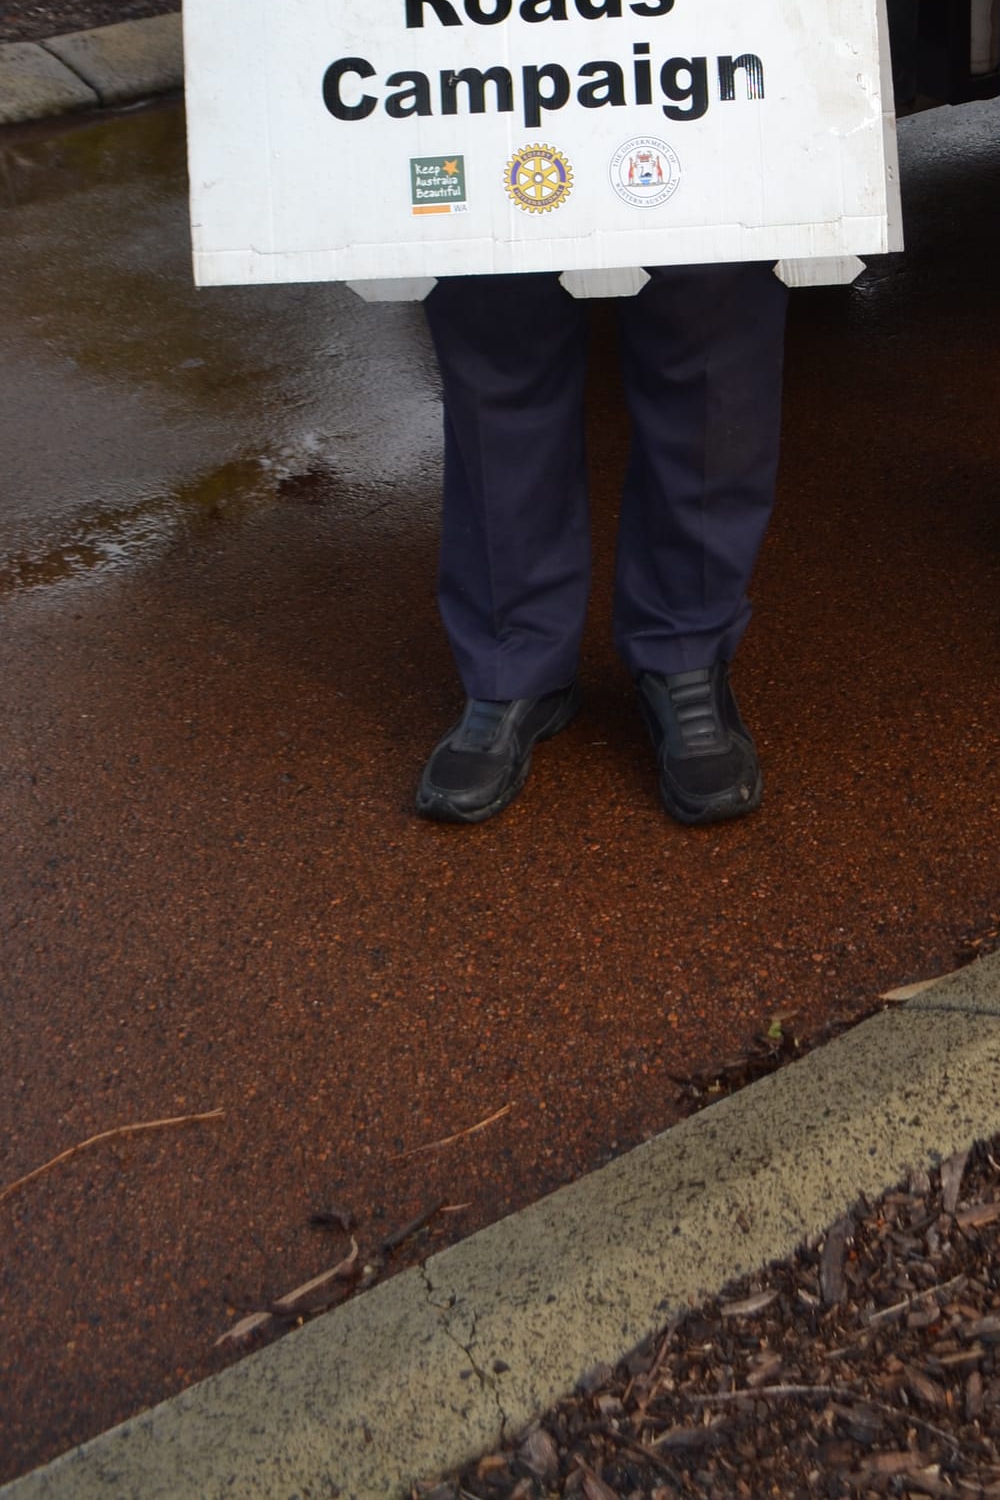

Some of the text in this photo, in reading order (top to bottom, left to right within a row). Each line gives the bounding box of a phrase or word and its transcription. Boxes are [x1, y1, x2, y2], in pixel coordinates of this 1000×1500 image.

[323, 43, 764, 127] Campaign
[621, 139, 671, 154] GOVERNMENT
[522, 151, 552, 160] ROTARY
[414, 163, 440, 177] Keep
[415, 175, 458, 186] Australia
[415, 185, 462, 198] Beautiful
[453, 204, 468, 212] WA
